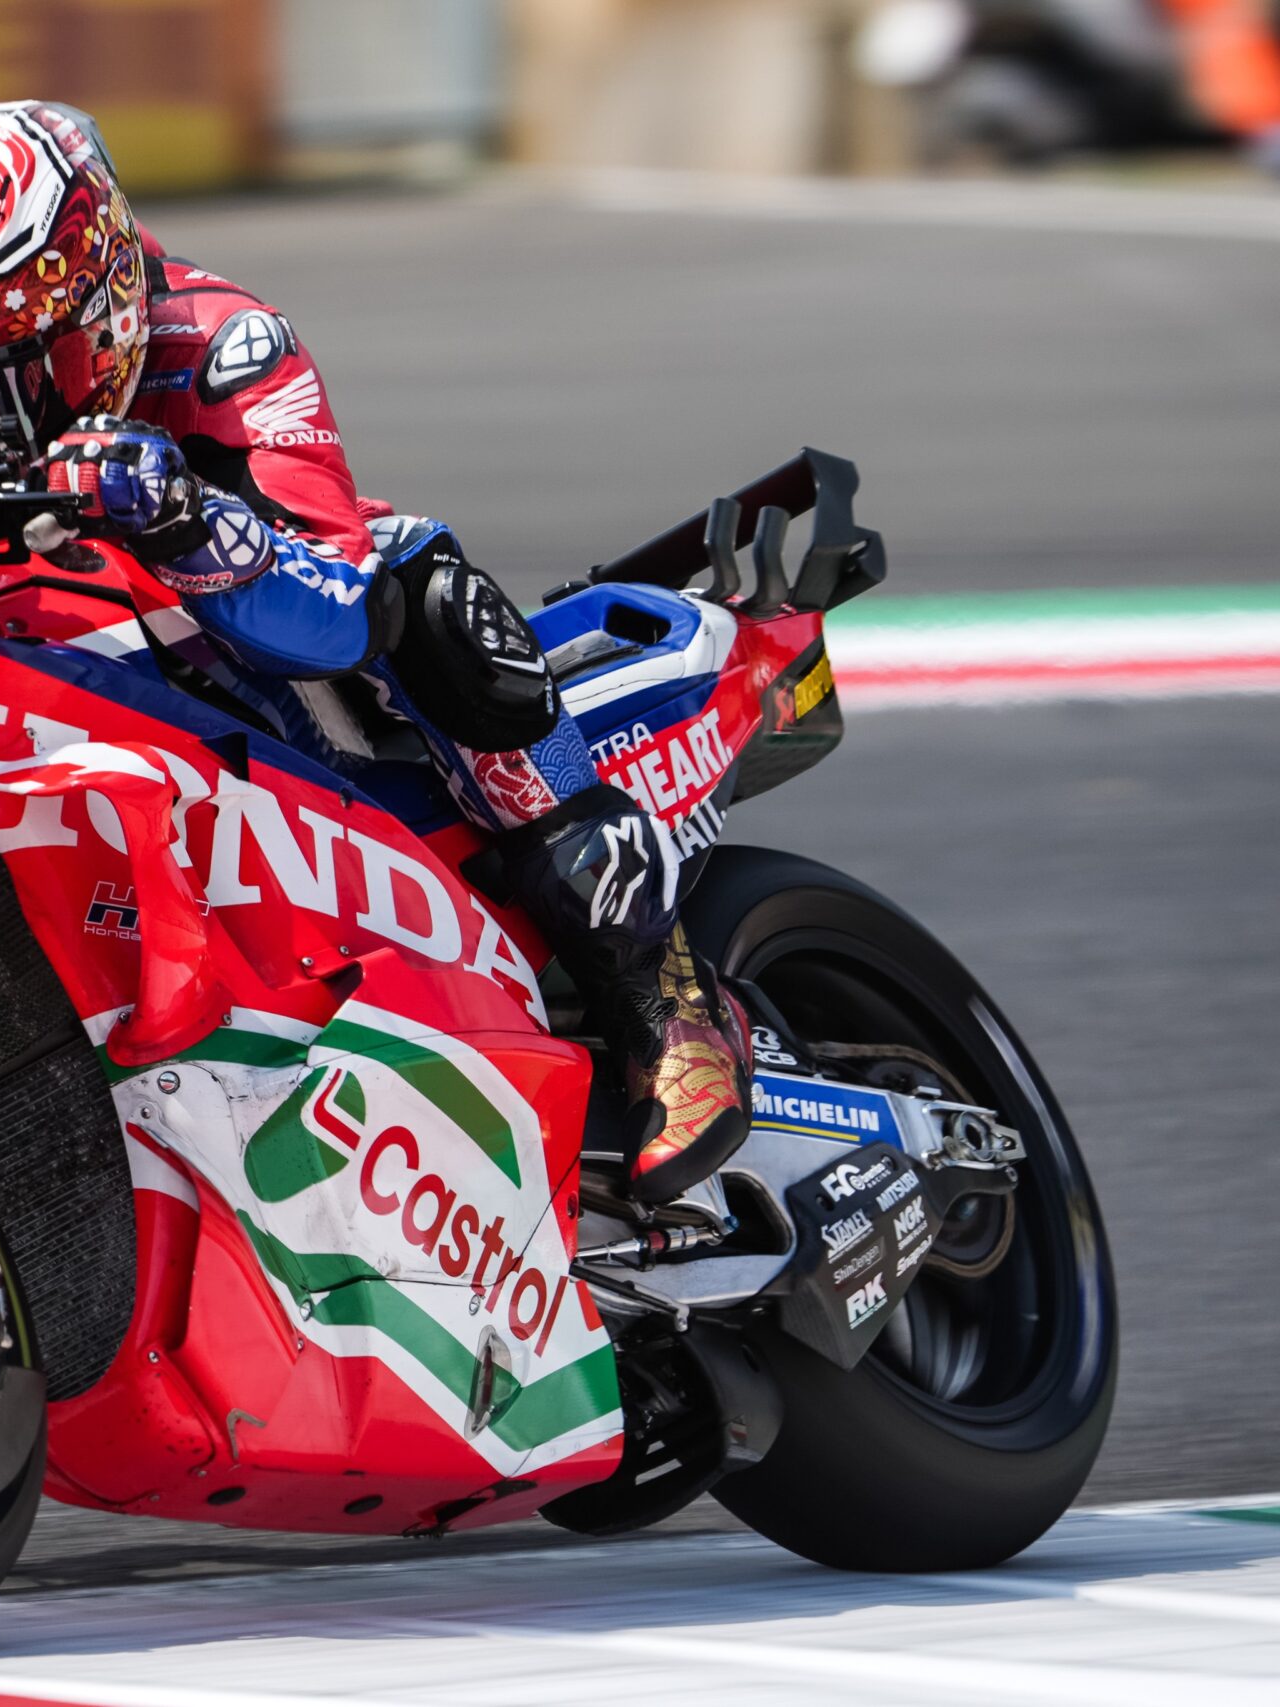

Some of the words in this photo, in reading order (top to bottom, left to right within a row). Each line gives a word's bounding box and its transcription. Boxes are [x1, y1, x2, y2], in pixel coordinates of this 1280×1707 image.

[608, 707, 734, 815] HEART.
[752, 1094, 879, 1132] MICHELIN
[360, 1126, 568, 1358] Castrol
[894, 1195, 925, 1241] NGK
[846, 1271, 887, 1324] RK
